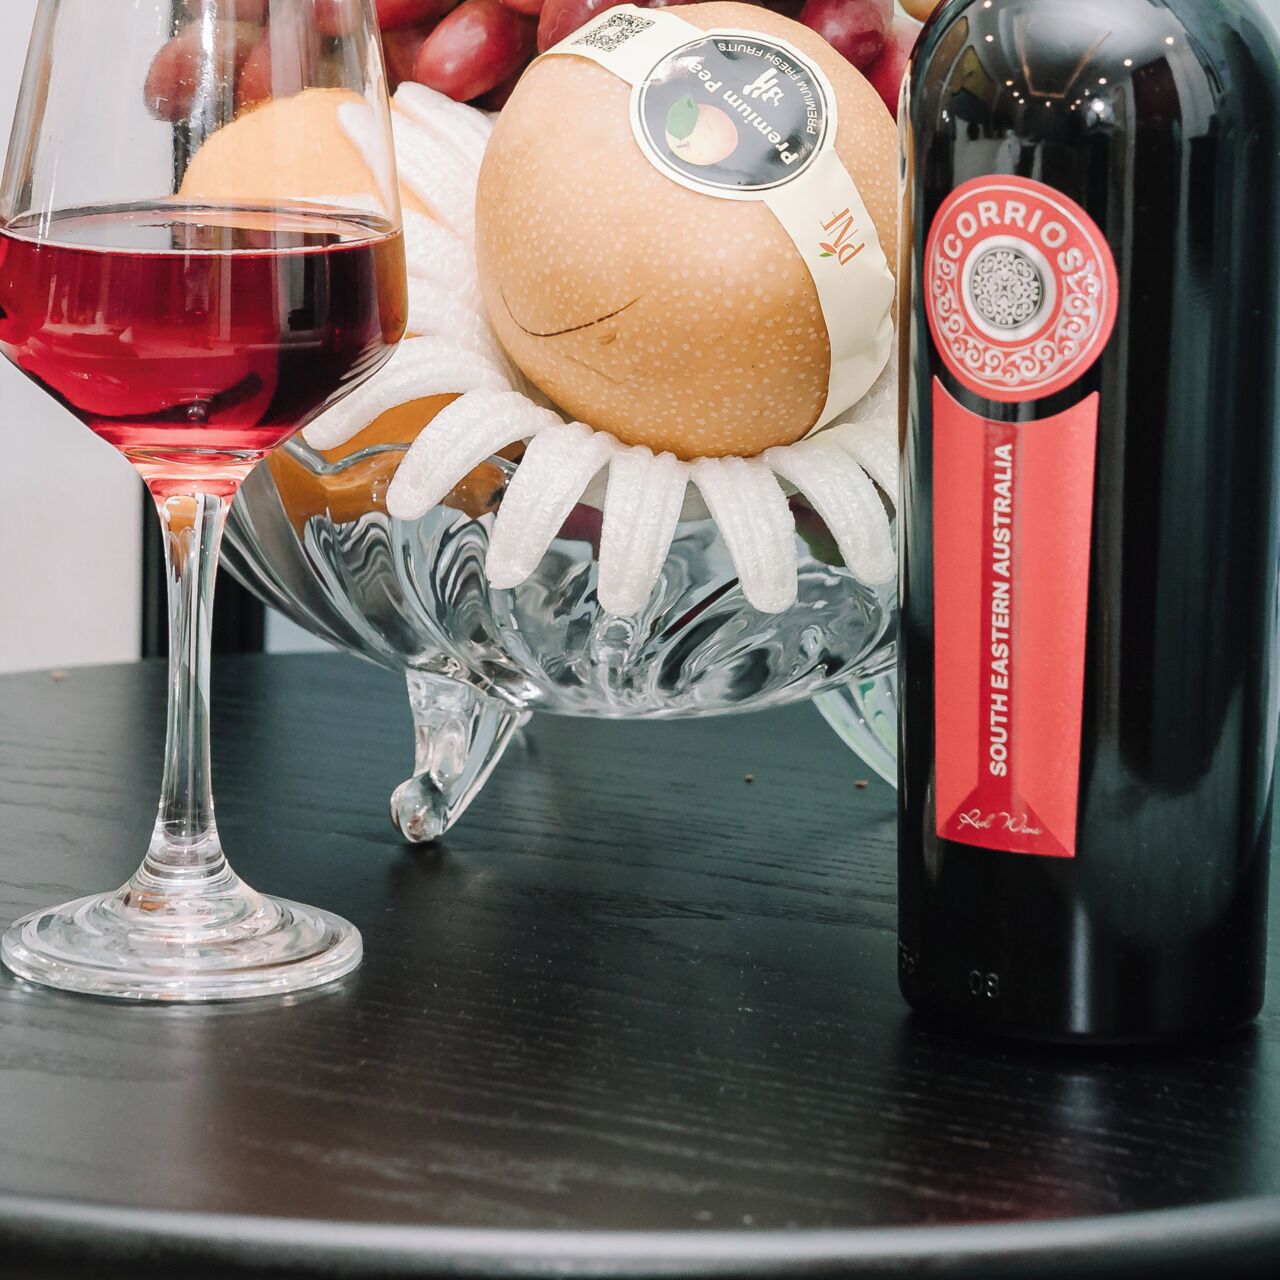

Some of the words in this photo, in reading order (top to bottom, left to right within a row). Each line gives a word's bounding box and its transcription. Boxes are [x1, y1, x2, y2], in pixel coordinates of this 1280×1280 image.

[684, 58, 723, 94] Pea
[717, 42, 765, 57] FRUITS
[764, 53, 801, 81] FRESH
[723, 89, 799, 165] Premium
[797, 79, 818, 135] PREMIUM
[943, 200, 1083, 272] CORRIOS
[992, 443, 1013, 578] AUSTRALIA
[990, 580, 1011, 690] EASTERN
[989, 693, 1009, 777] SOUTH
